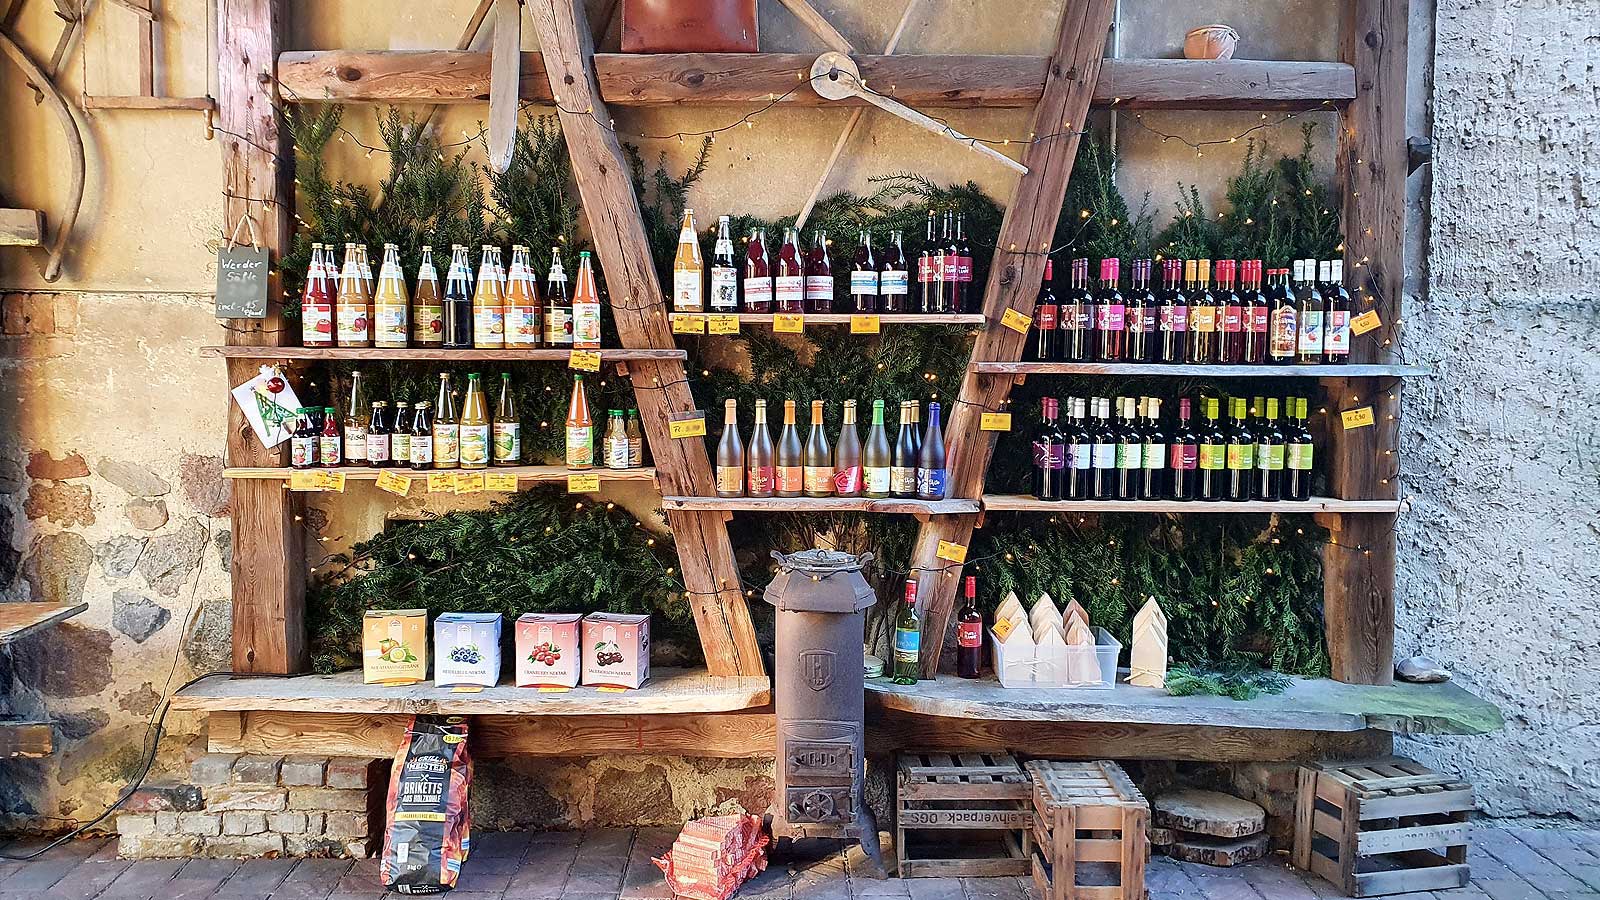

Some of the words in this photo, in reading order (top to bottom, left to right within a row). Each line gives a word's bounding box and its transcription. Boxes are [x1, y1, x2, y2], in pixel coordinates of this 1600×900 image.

[221, 258, 262, 269] Werder
[409, 762, 445, 773] MEISTER
[404, 781, 443, 795] BRIKETTS
[413, 795, 441, 803] HOLZKOHLE
